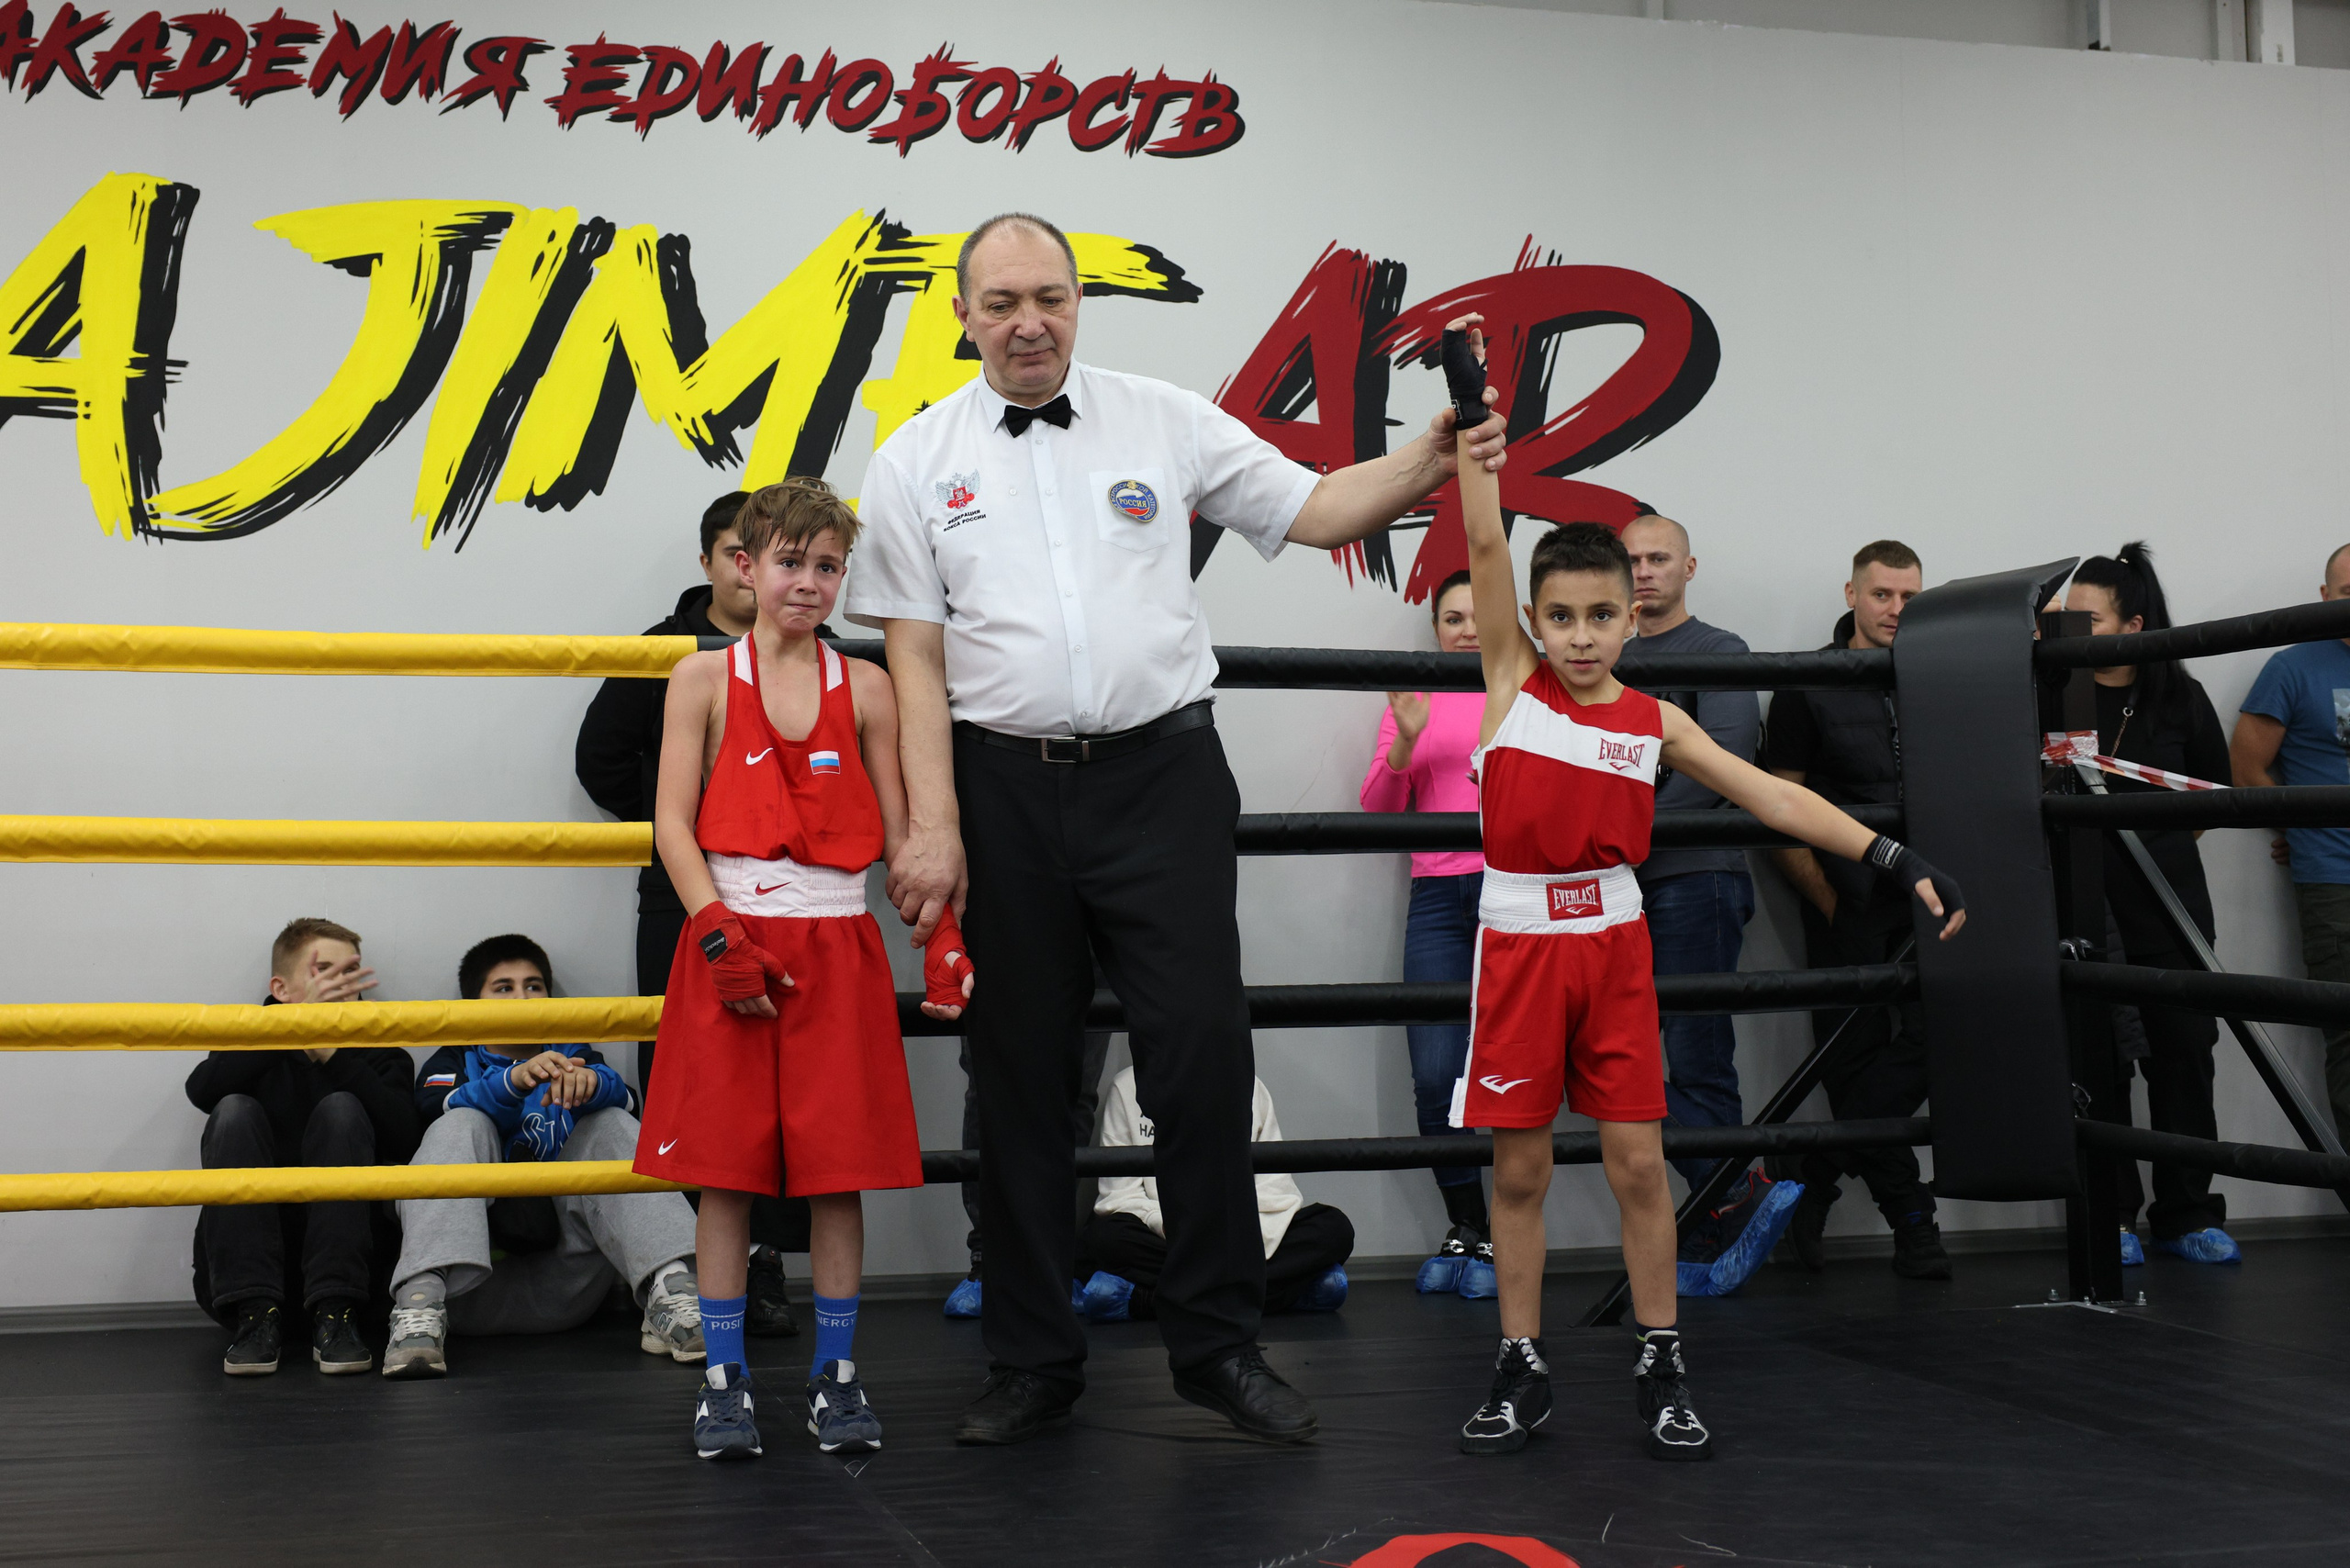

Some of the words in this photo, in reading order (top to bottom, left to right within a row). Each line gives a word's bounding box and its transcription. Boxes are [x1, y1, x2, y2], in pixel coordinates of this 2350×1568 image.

[543, 31, 1246, 159] ЕДИНОБОРСТВ
[1118, 498, 1147, 508] РОССИЯ
[943, 521, 961, 532] БОКСА
[962, 513, 987, 524] РОССИИ
[947, 509, 981, 525] ФЕДЕРАЦИЯ
[1598, 737, 1645, 769] EVERLAST
[1552, 883, 1596, 911] EVERLAST
[815, 1314, 856, 1327] NERGY
